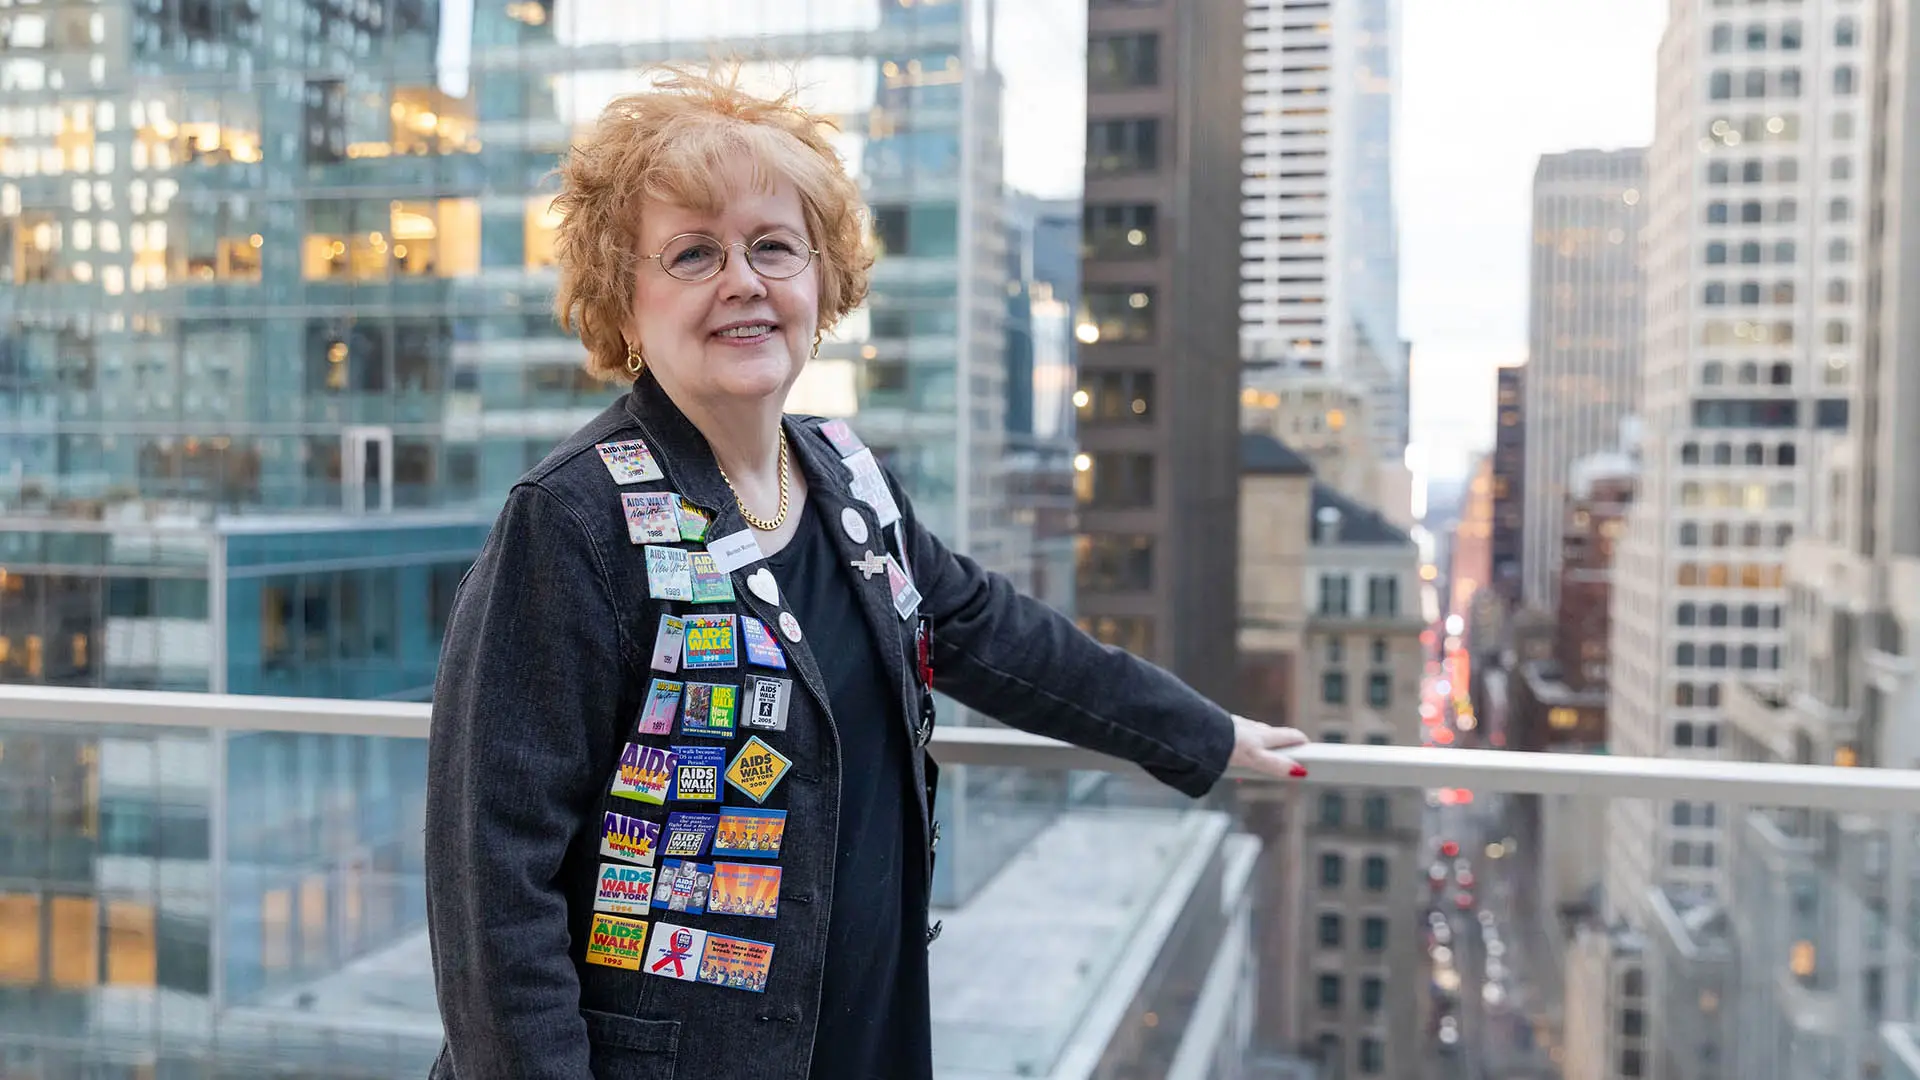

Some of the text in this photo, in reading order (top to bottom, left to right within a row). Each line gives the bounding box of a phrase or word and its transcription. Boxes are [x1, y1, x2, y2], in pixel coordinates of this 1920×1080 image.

[622, 443, 643, 452] Walk
[627, 496, 670, 508] AIDS WALK
[649, 549, 688, 560] AIDS WALK
[664, 587, 681, 596] 1989
[688, 627, 732, 640] AIDS
[688, 637, 732, 651] WALK
[713, 687, 731, 698] AIDS
[712, 697, 734, 708] WALK
[712, 707, 729, 717] New
[652, 721, 665, 731] 1991
[712, 717, 729, 727] York
[619, 743, 680, 781] AIDS
[740, 753, 772, 769] AIDS
[621, 765, 669, 789] WALK
[681, 768, 714, 780] AIDS
[740, 765, 773, 778] WALK
[623, 777, 639, 787] NEW
[681, 779, 714, 789] WALK
[741, 776, 755, 784] NEW
[603, 813, 660, 849] AIDS
[607, 831, 650, 853] WALK
[673, 833, 701, 841] AIDS
[610, 842, 646, 856] NEW YORK
[671, 840, 699, 848] WALK
[601, 867, 652, 883] AIDS
[601, 879, 649, 894] WALK
[676, 878, 693, 886] AIDS
[599, 890, 648, 901] NEW YORK
[616, 920, 644, 929] ANNUAL
[595, 923, 643, 940] AIDS
[594, 933, 641, 951] WALK
[711, 940, 768, 954] Tough times didn't
[591, 943, 612, 953] NEW
[614, 947, 639, 957] YORK
[712, 946, 731, 954] break
[603, 956, 623, 966] 1995
